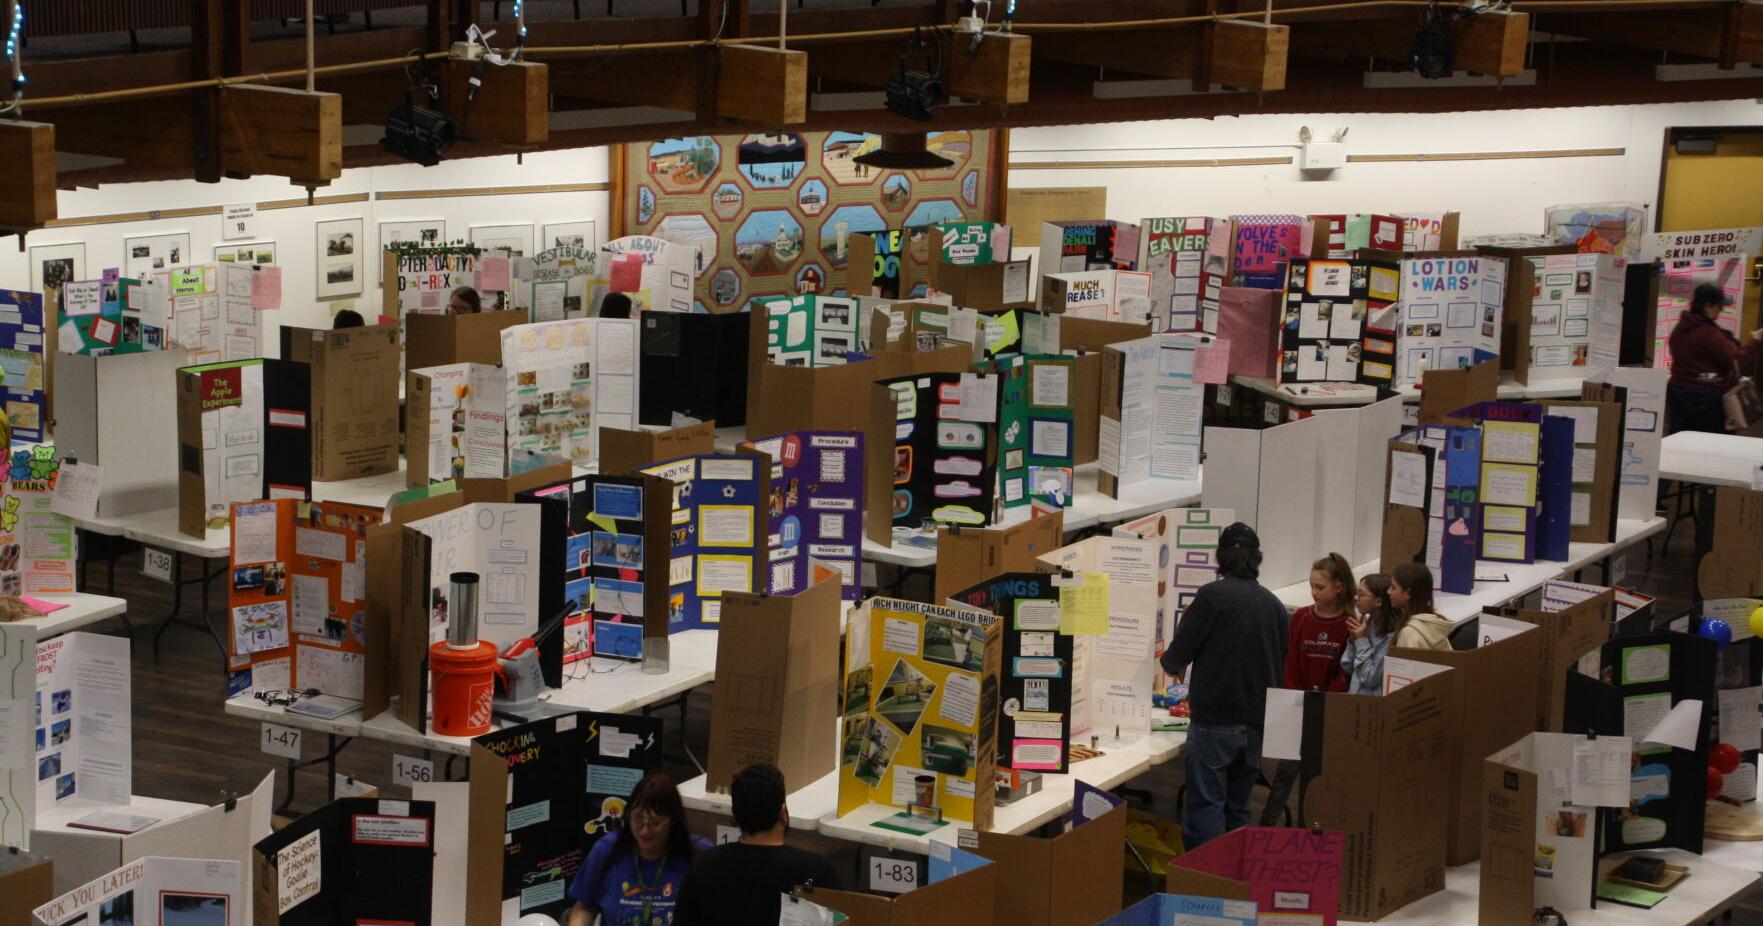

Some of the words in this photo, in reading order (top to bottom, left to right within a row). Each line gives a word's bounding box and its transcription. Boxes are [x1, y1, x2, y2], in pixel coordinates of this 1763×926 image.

[532, 246, 597, 267] VESTIBULAR
[1665, 248, 1695, 259] SKIN
[1411, 260, 1478, 276] LOTION
[1073, 280, 1099, 291] MUCH
[1422, 276, 1469, 292] WARS
[213, 379, 227, 387] The
[211, 386, 232, 399] Apple
[12, 481, 46, 491] BEARS
[477, 508, 518, 534] OF
[148, 553, 169, 570] 1-38
[265, 727, 299, 748] 1-47
[397, 762, 431, 783] 1-56
[875, 861, 914, 882] 1-83
